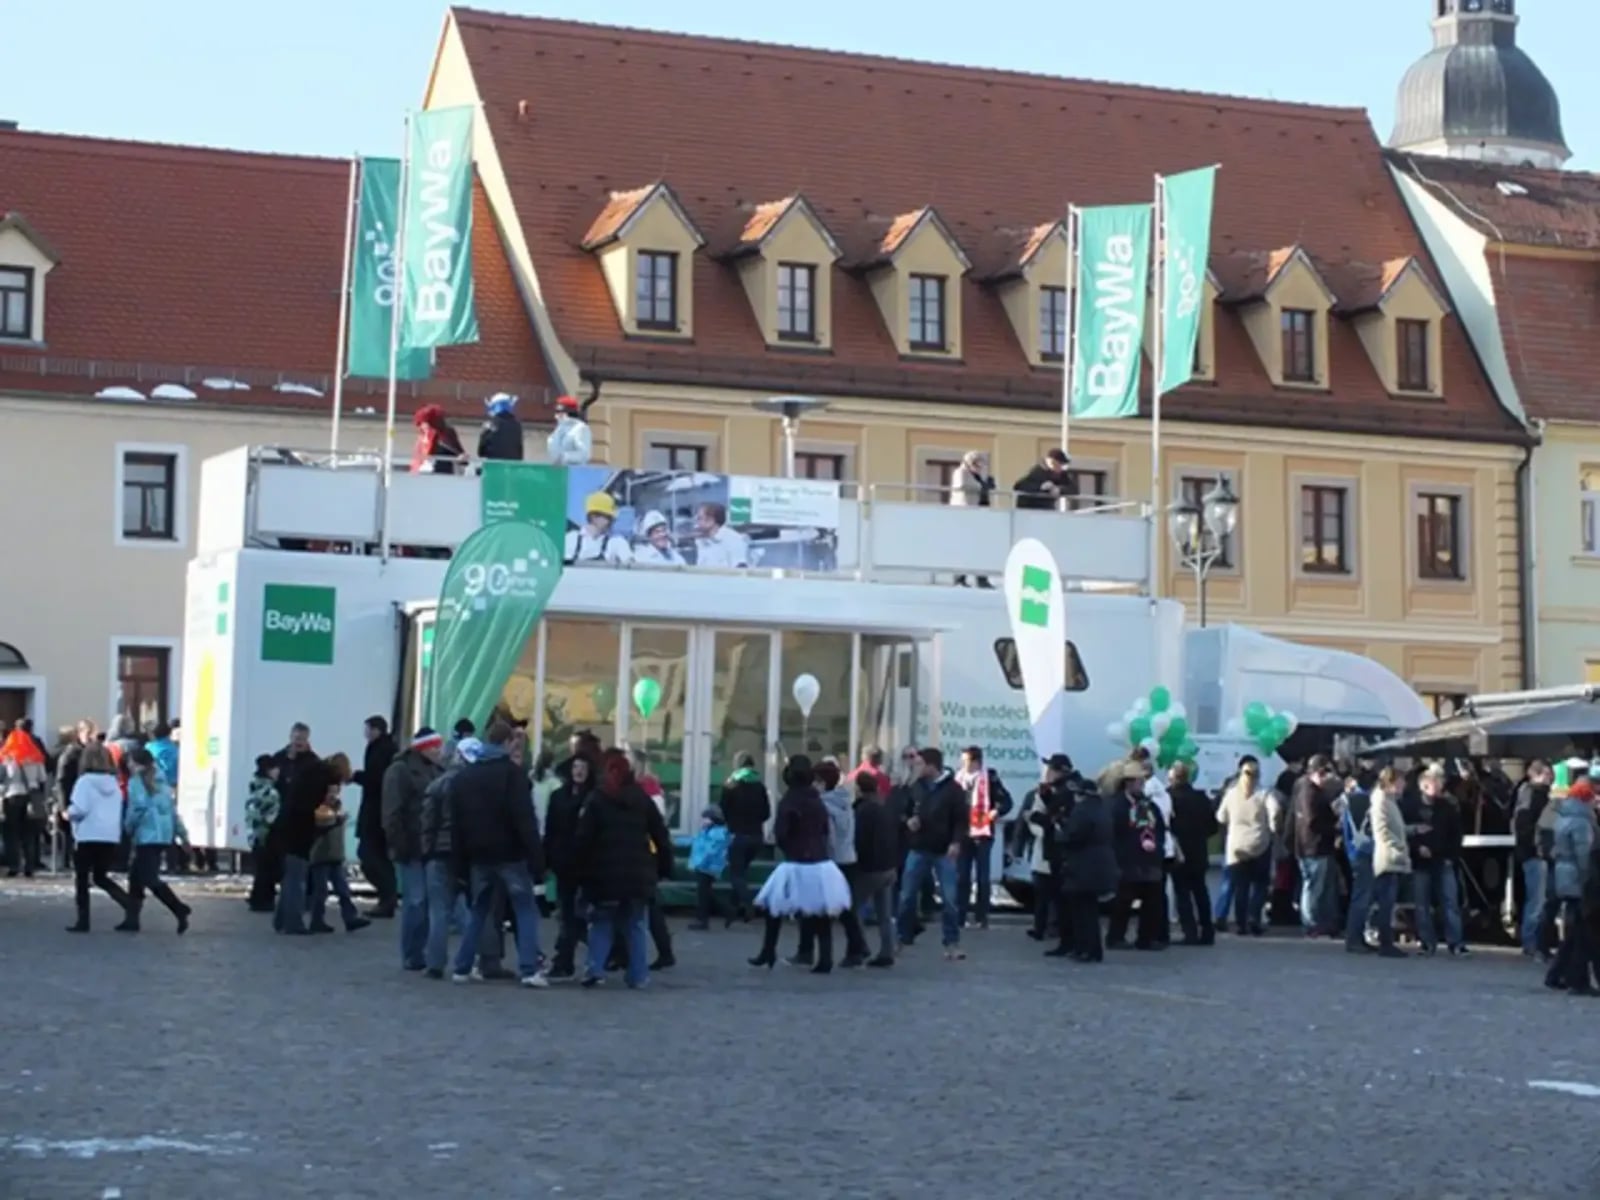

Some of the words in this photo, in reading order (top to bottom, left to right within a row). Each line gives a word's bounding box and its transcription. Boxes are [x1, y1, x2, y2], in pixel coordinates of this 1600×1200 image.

[416, 139, 460, 323] BayWa
[1087, 234, 1138, 397] BayWa
[265, 609, 332, 635] BayWa
[463, 563, 509, 596] 90
